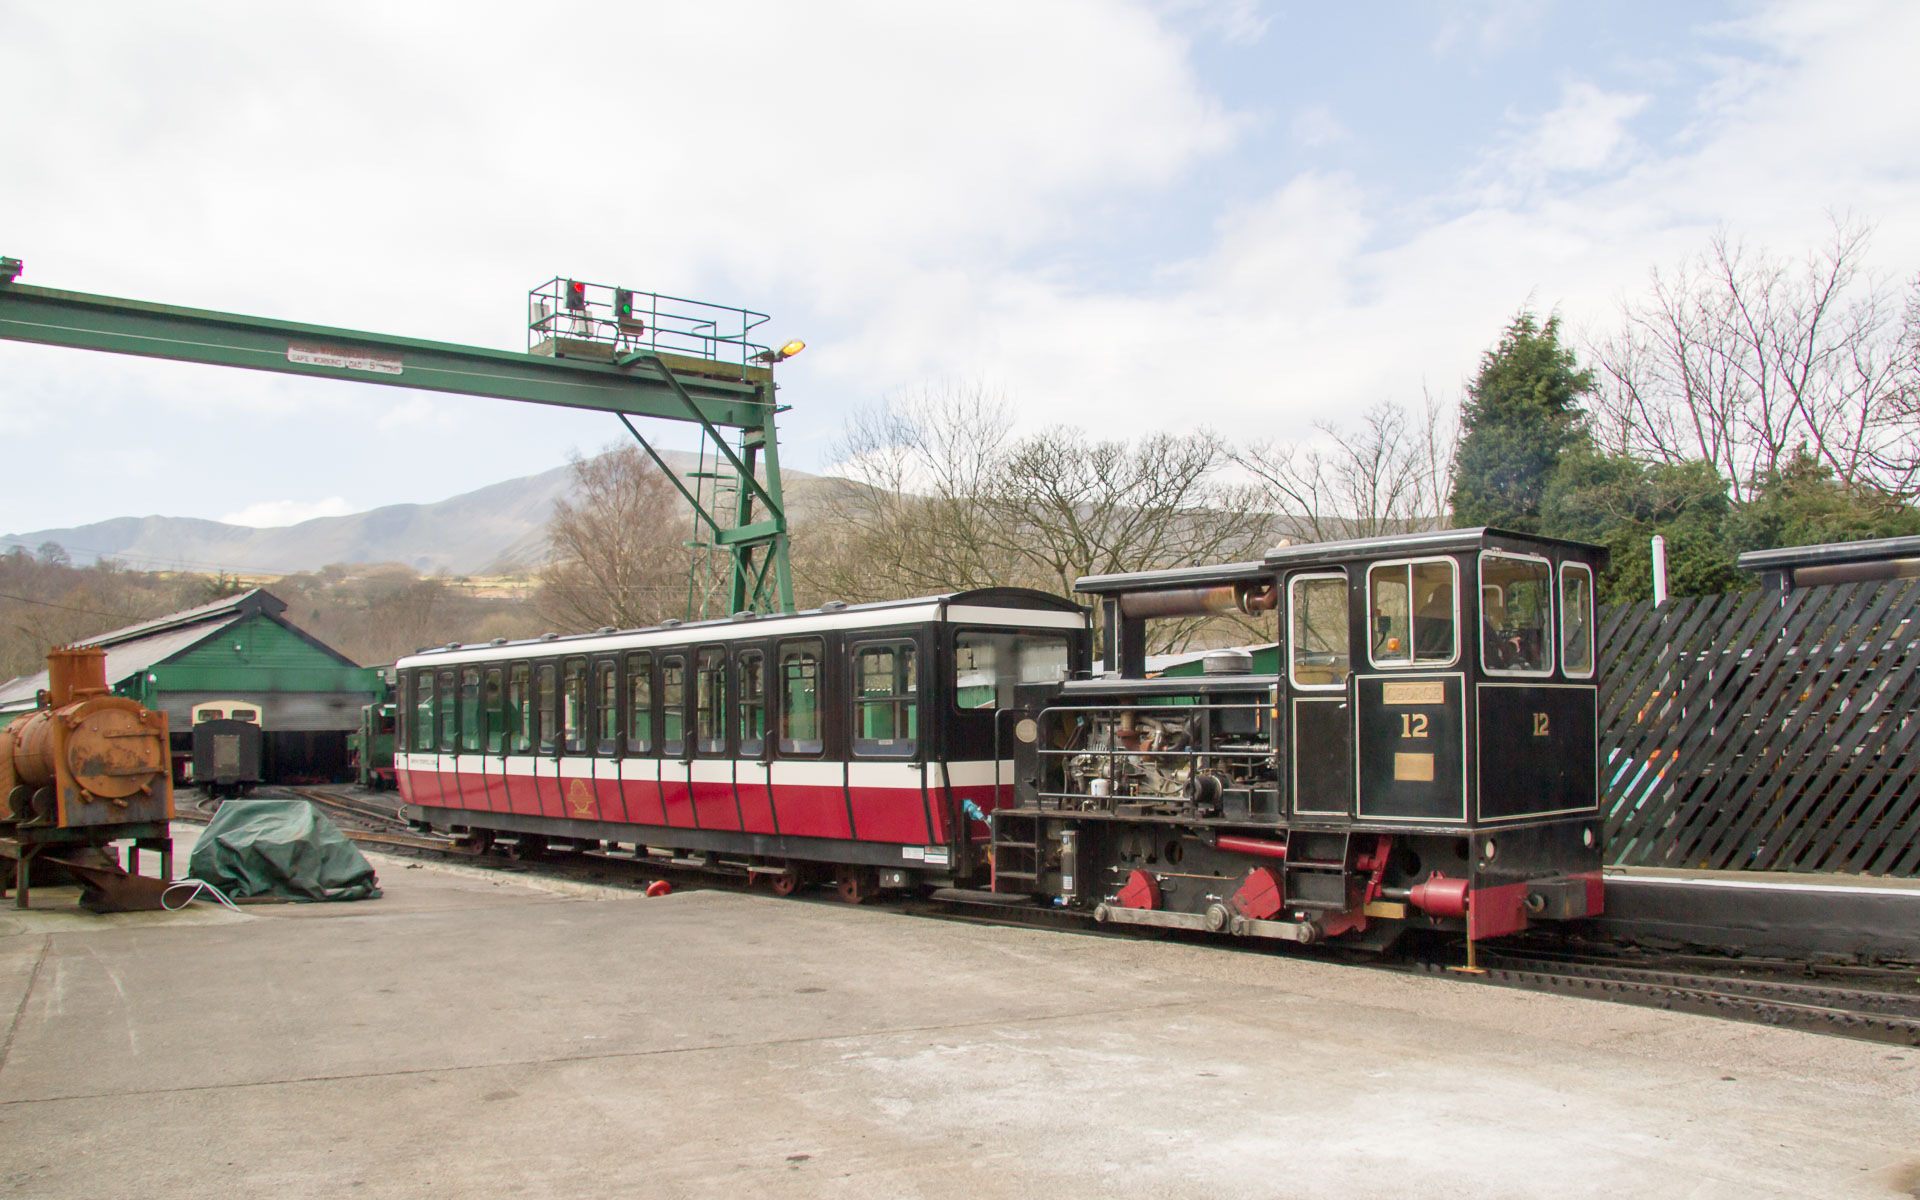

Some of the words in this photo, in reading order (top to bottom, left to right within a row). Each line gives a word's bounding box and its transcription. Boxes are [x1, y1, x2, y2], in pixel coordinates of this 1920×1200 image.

[291, 354, 311, 363] SAFE
[314, 357, 342, 366] WORKING
[344, 359, 362, 369] LOAD
[369, 361, 376, 370] 5
[1387, 686, 1441, 701] GEORGE
[1401, 713, 1428, 738] 12
[1532, 713, 1549, 736] 12
